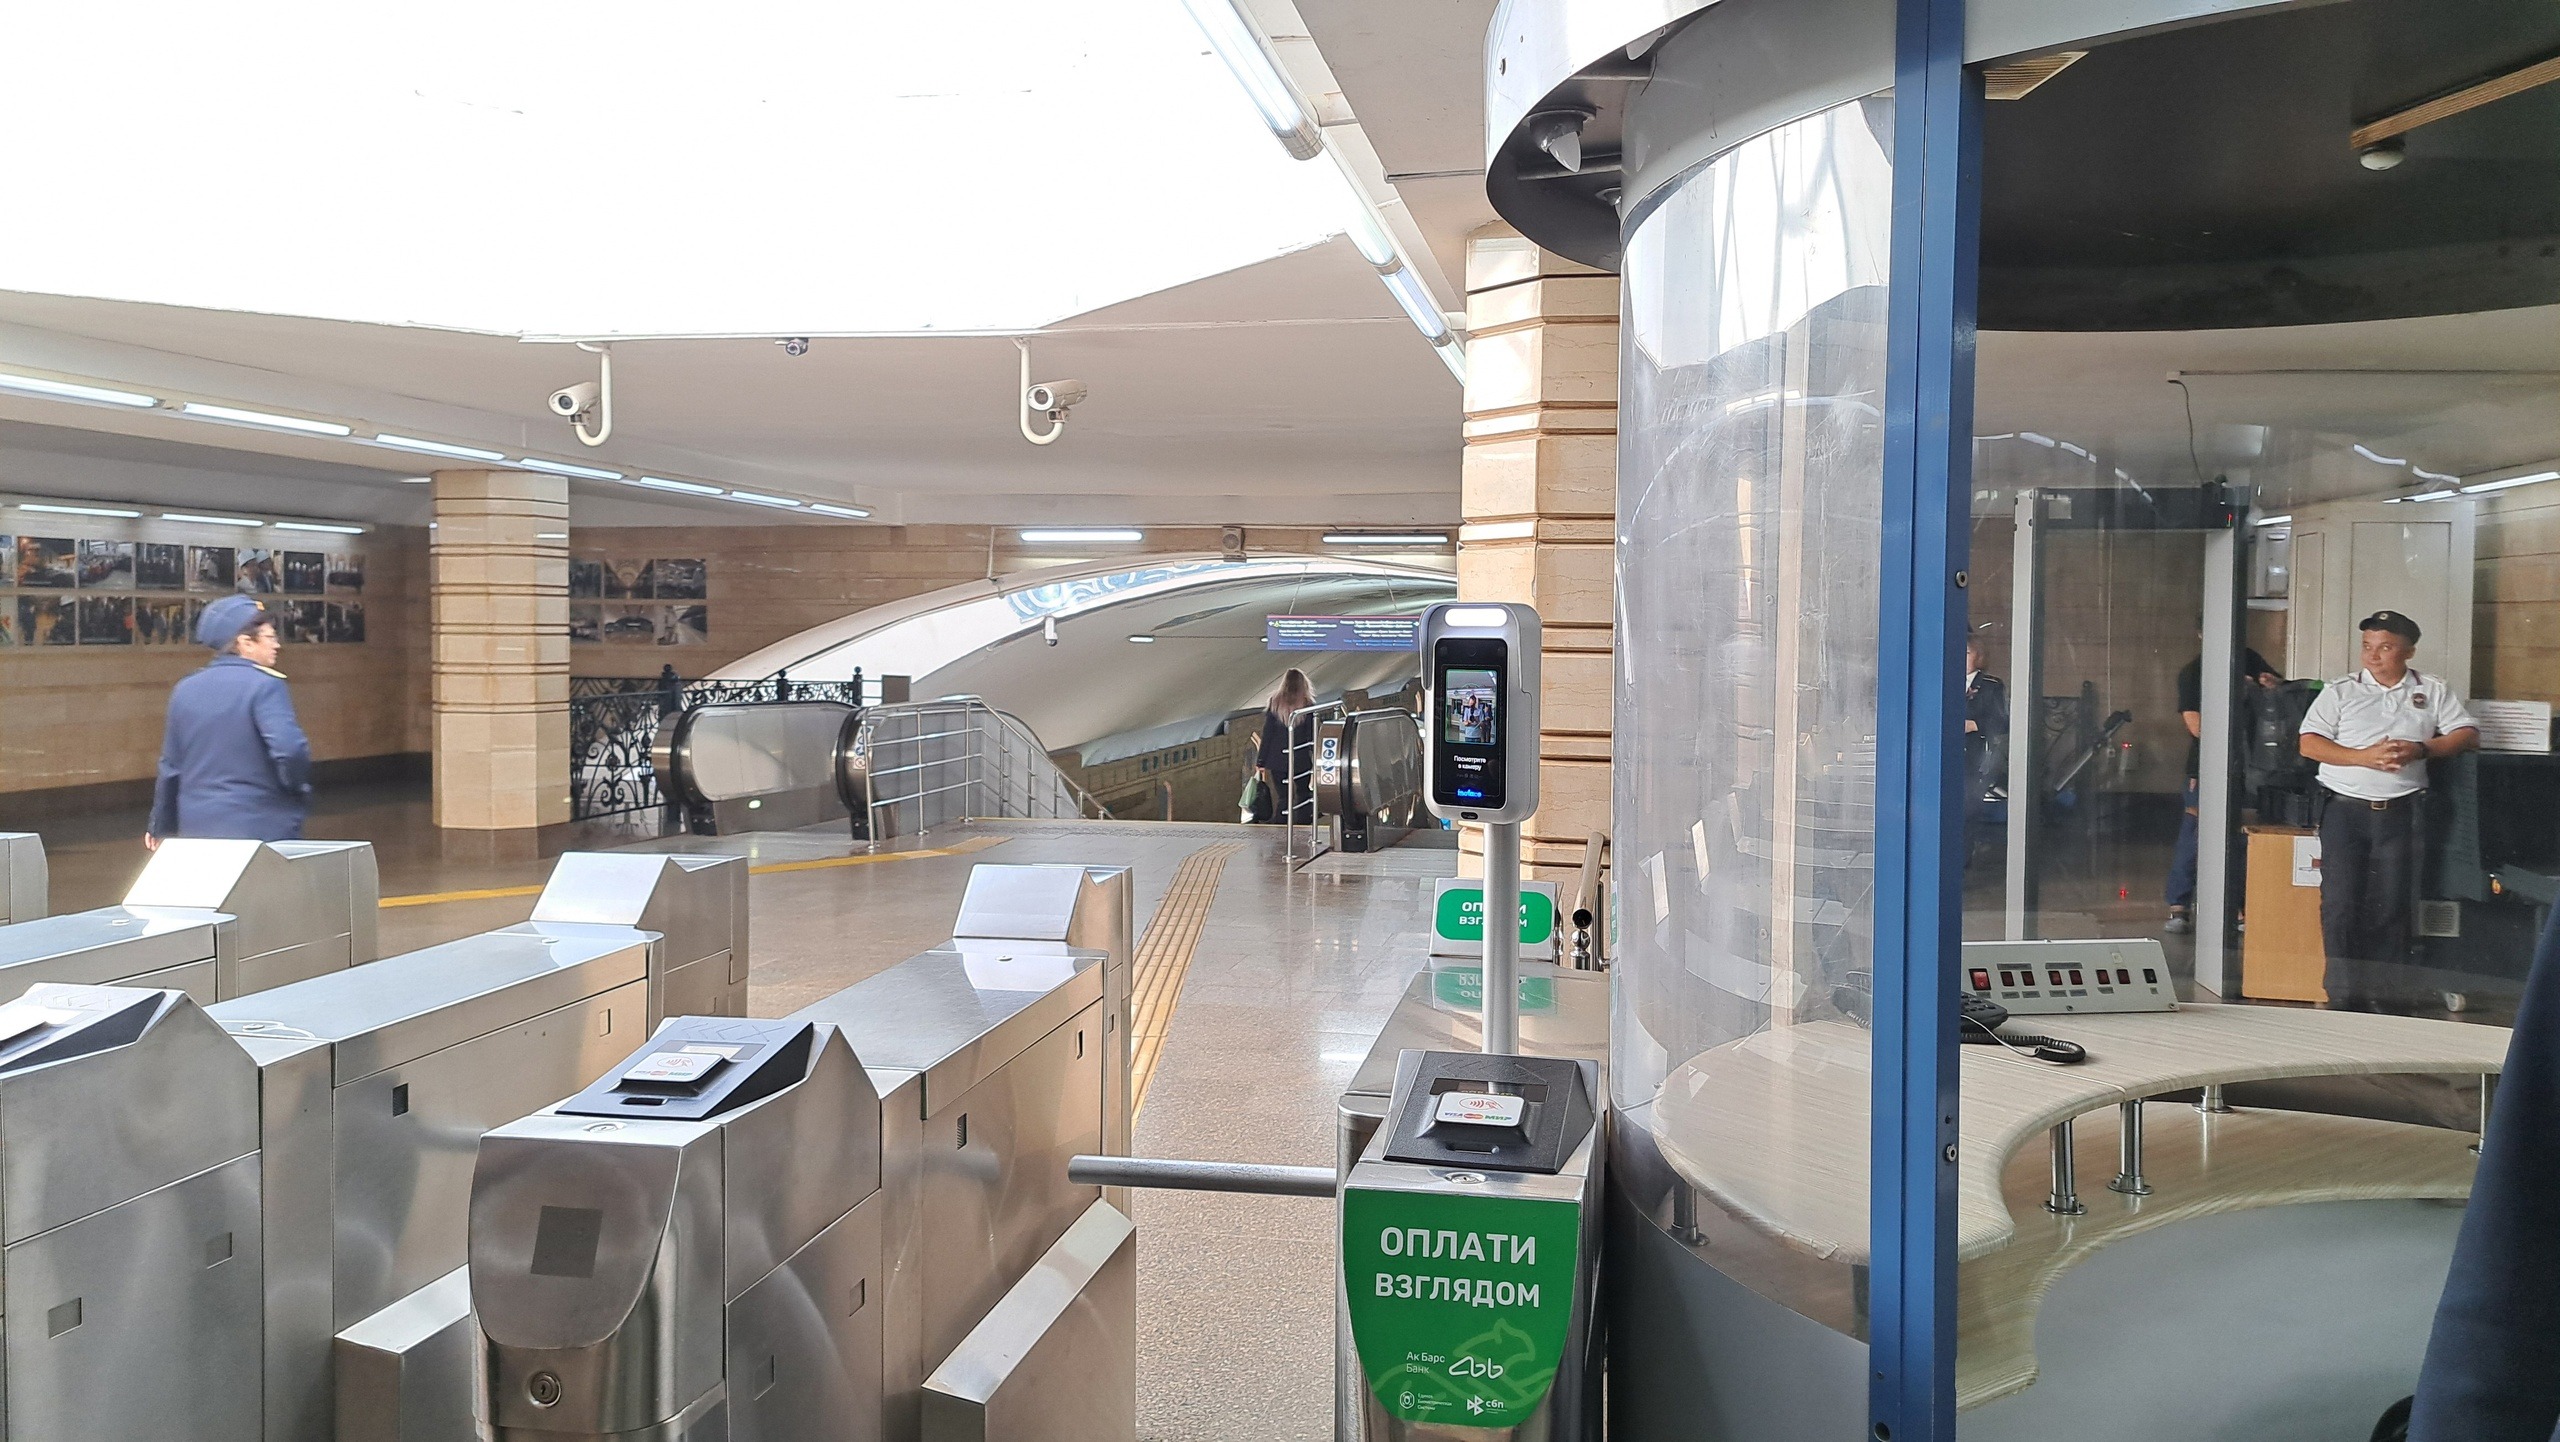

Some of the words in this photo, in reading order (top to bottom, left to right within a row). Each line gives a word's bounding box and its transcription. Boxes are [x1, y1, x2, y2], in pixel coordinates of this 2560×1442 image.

[1380, 1226, 1536, 1265] ОПЛАТИ
[1375, 1272, 1540, 1309] ВЗГЛЯДОМ
[1406, 1351, 1420, 1361] Ак
[1421, 1352, 1446, 1364] Барс
[1406, 1363, 1430, 1374] Банк
[1485, 1399, 1504, 1409] сбп
